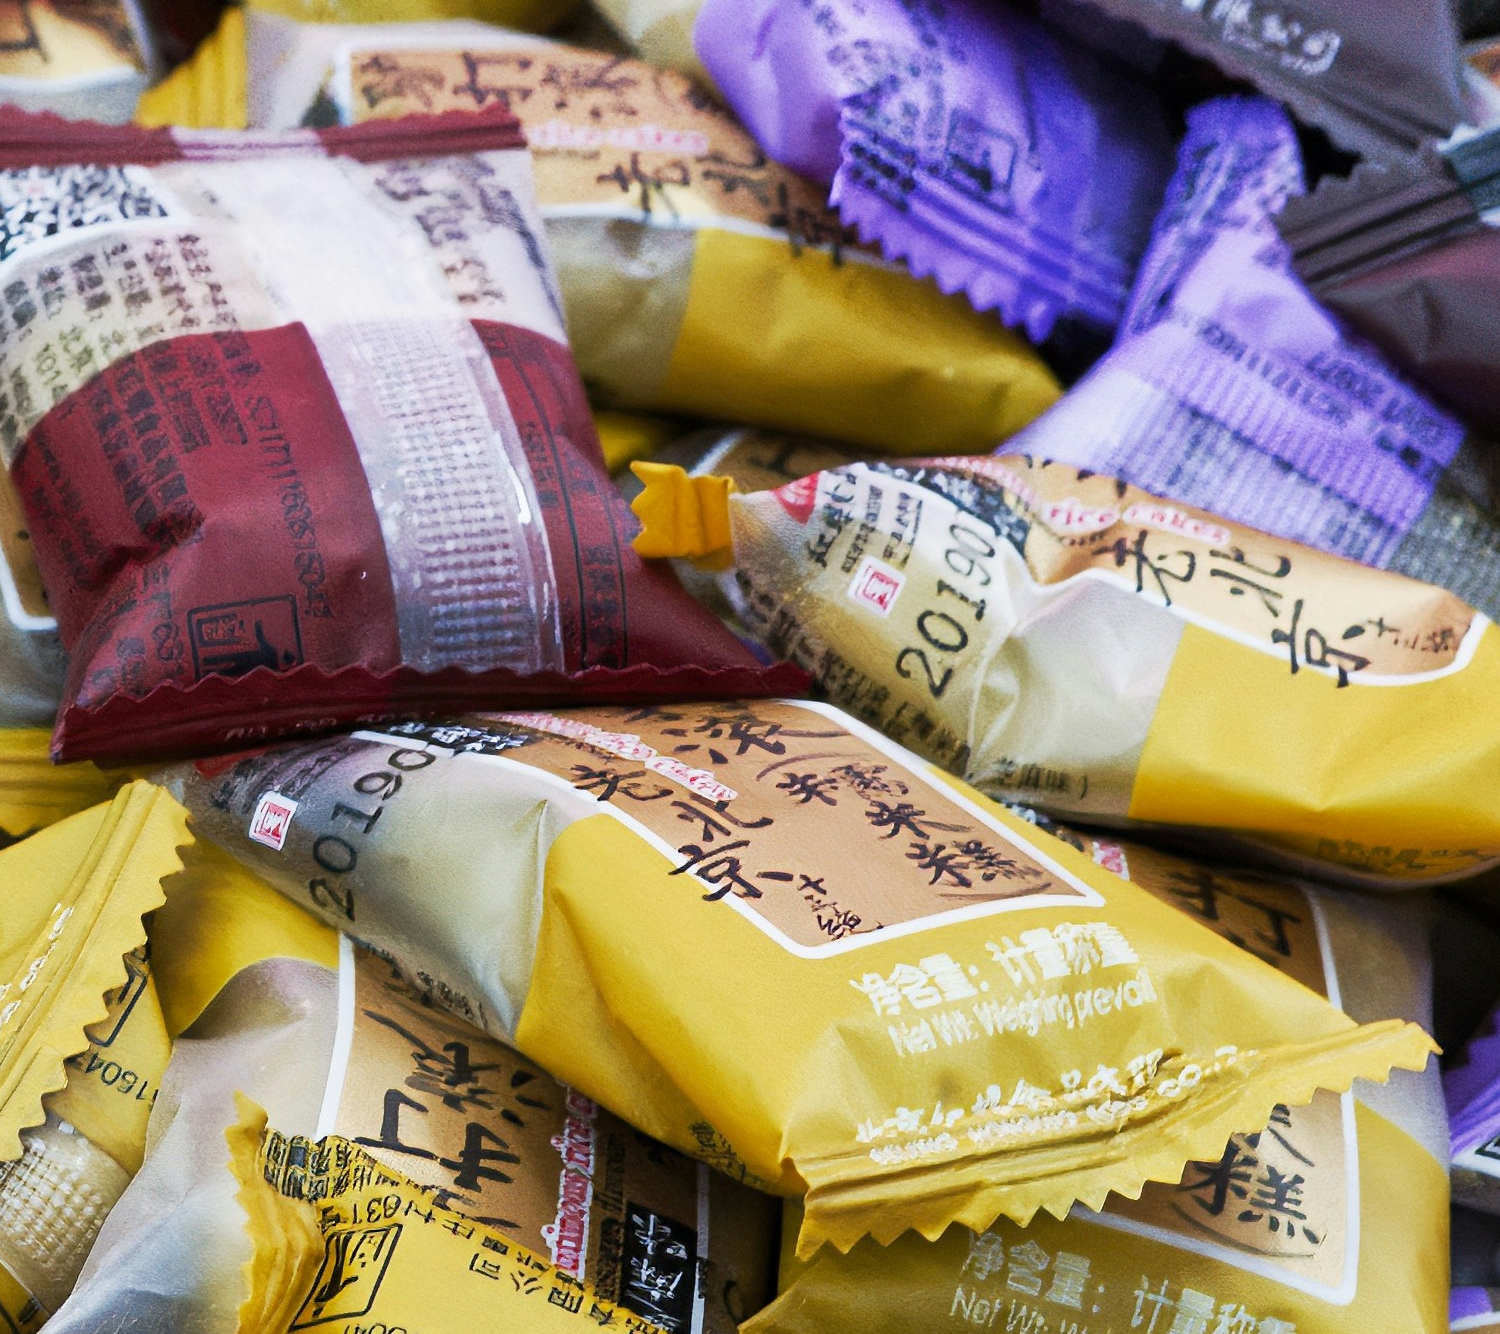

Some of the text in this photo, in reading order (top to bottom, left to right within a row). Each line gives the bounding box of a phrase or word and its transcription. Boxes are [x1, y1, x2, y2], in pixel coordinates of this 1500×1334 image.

[1095, 529, 1372, 689] 老北京
[573, 762, 796, 903] 老北京
[948, 1283, 1000, 1329] Net
